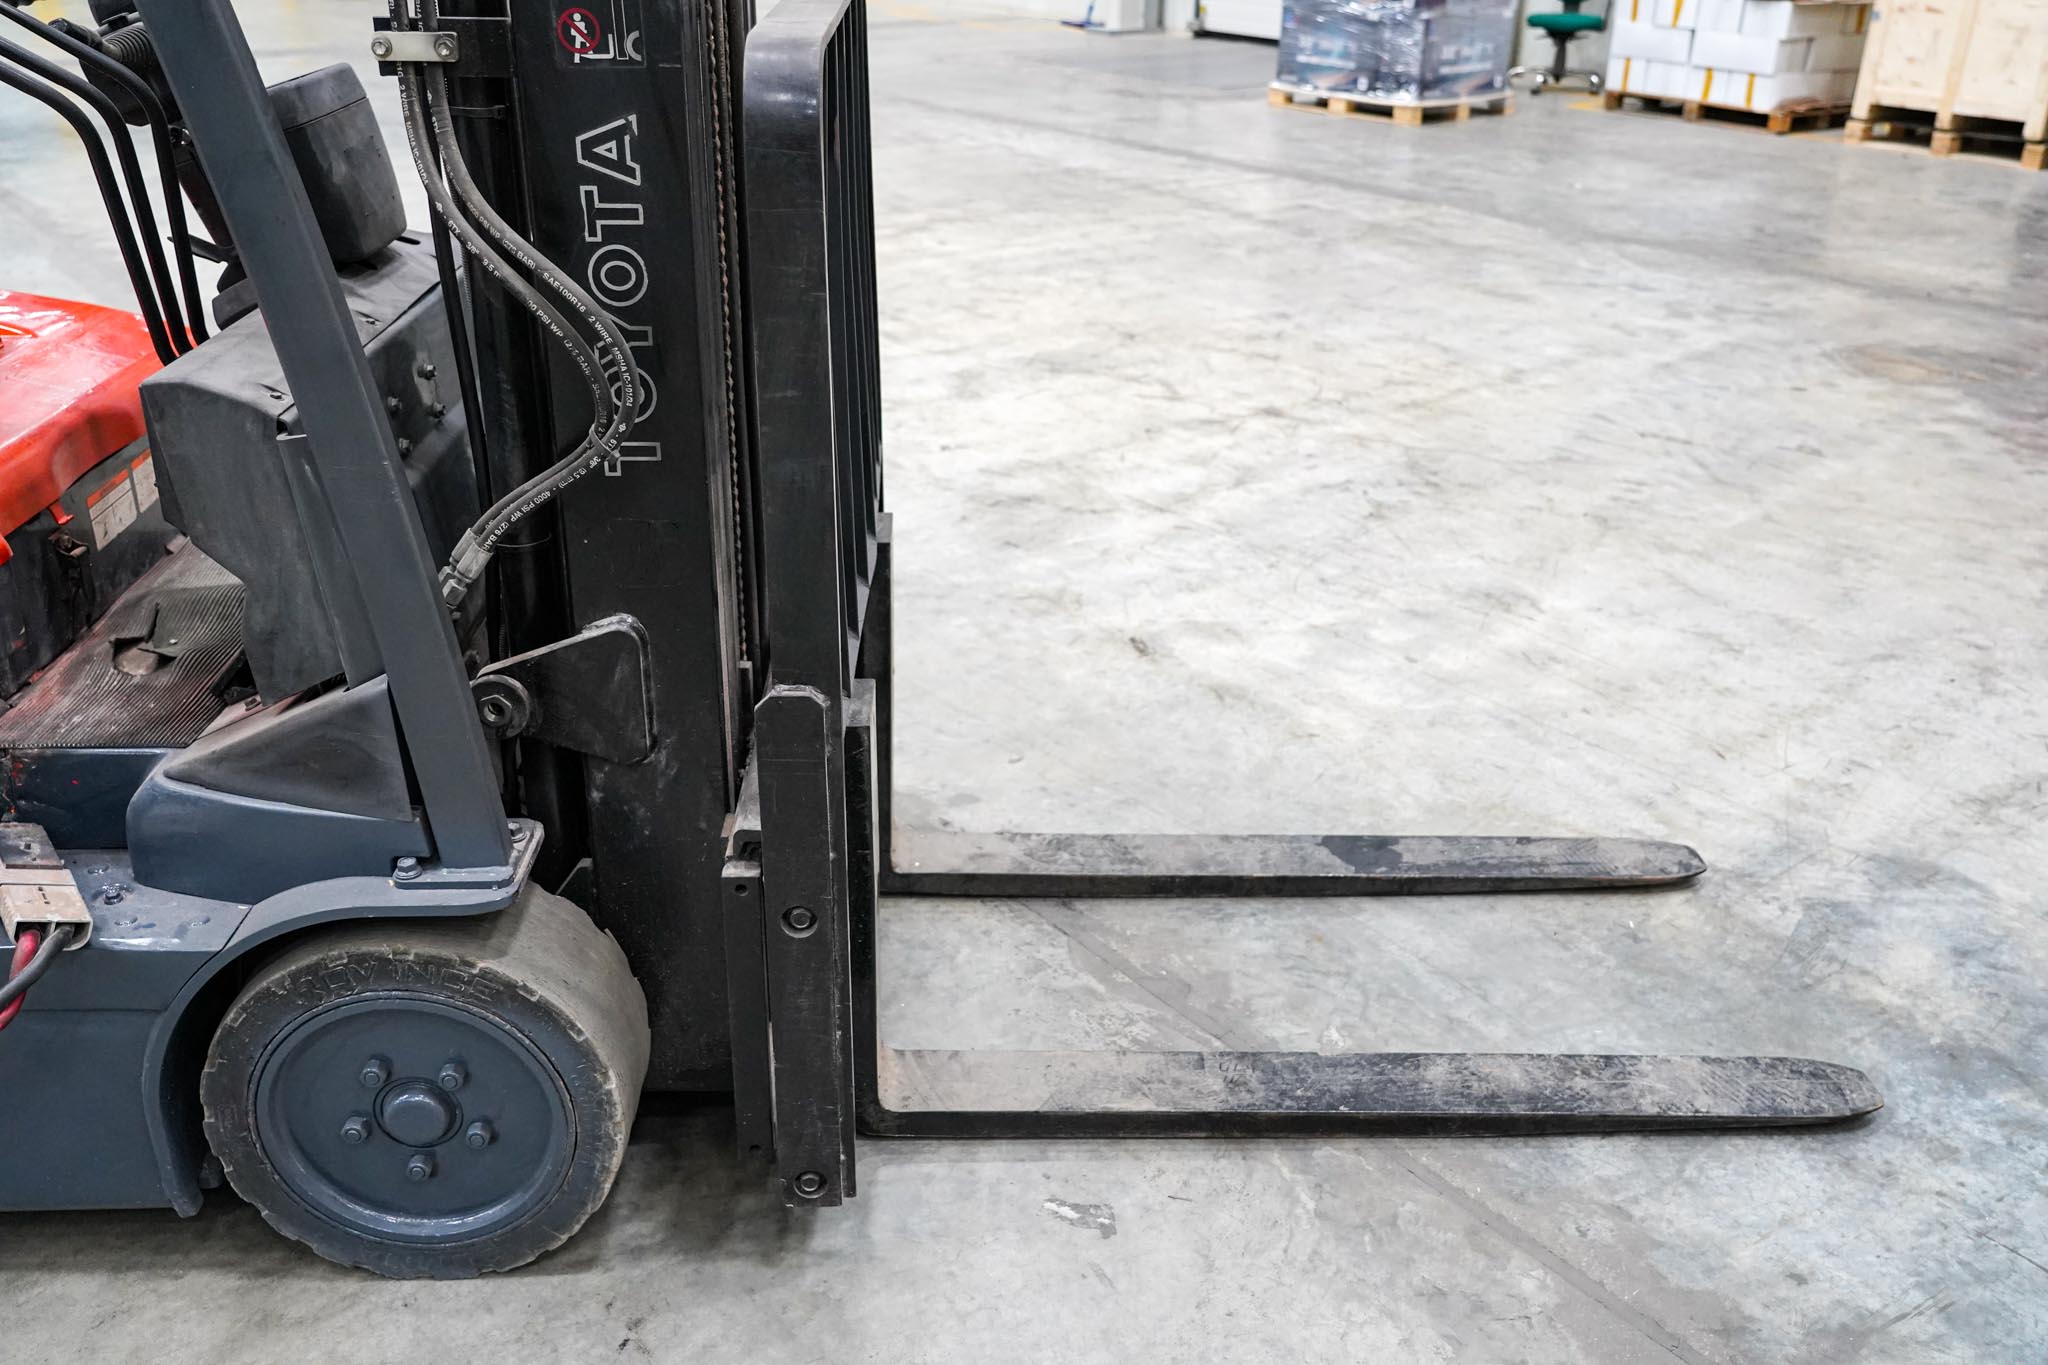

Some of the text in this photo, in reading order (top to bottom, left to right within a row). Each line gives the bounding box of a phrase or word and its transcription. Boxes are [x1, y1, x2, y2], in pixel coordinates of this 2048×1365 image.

[576, 113, 663, 477] TOYOTA
[536, 310, 551, 324] PSI
[549, 323, 564, 337] WP
[588, 315, 596, 323] 2
[594, 321, 613, 345] WIRE
[611, 347, 628, 372] MSHA
[521, 501, 535, 513] PSI
[534, 490, 551, 504] 4000
[510, 510, 524, 522] WP
